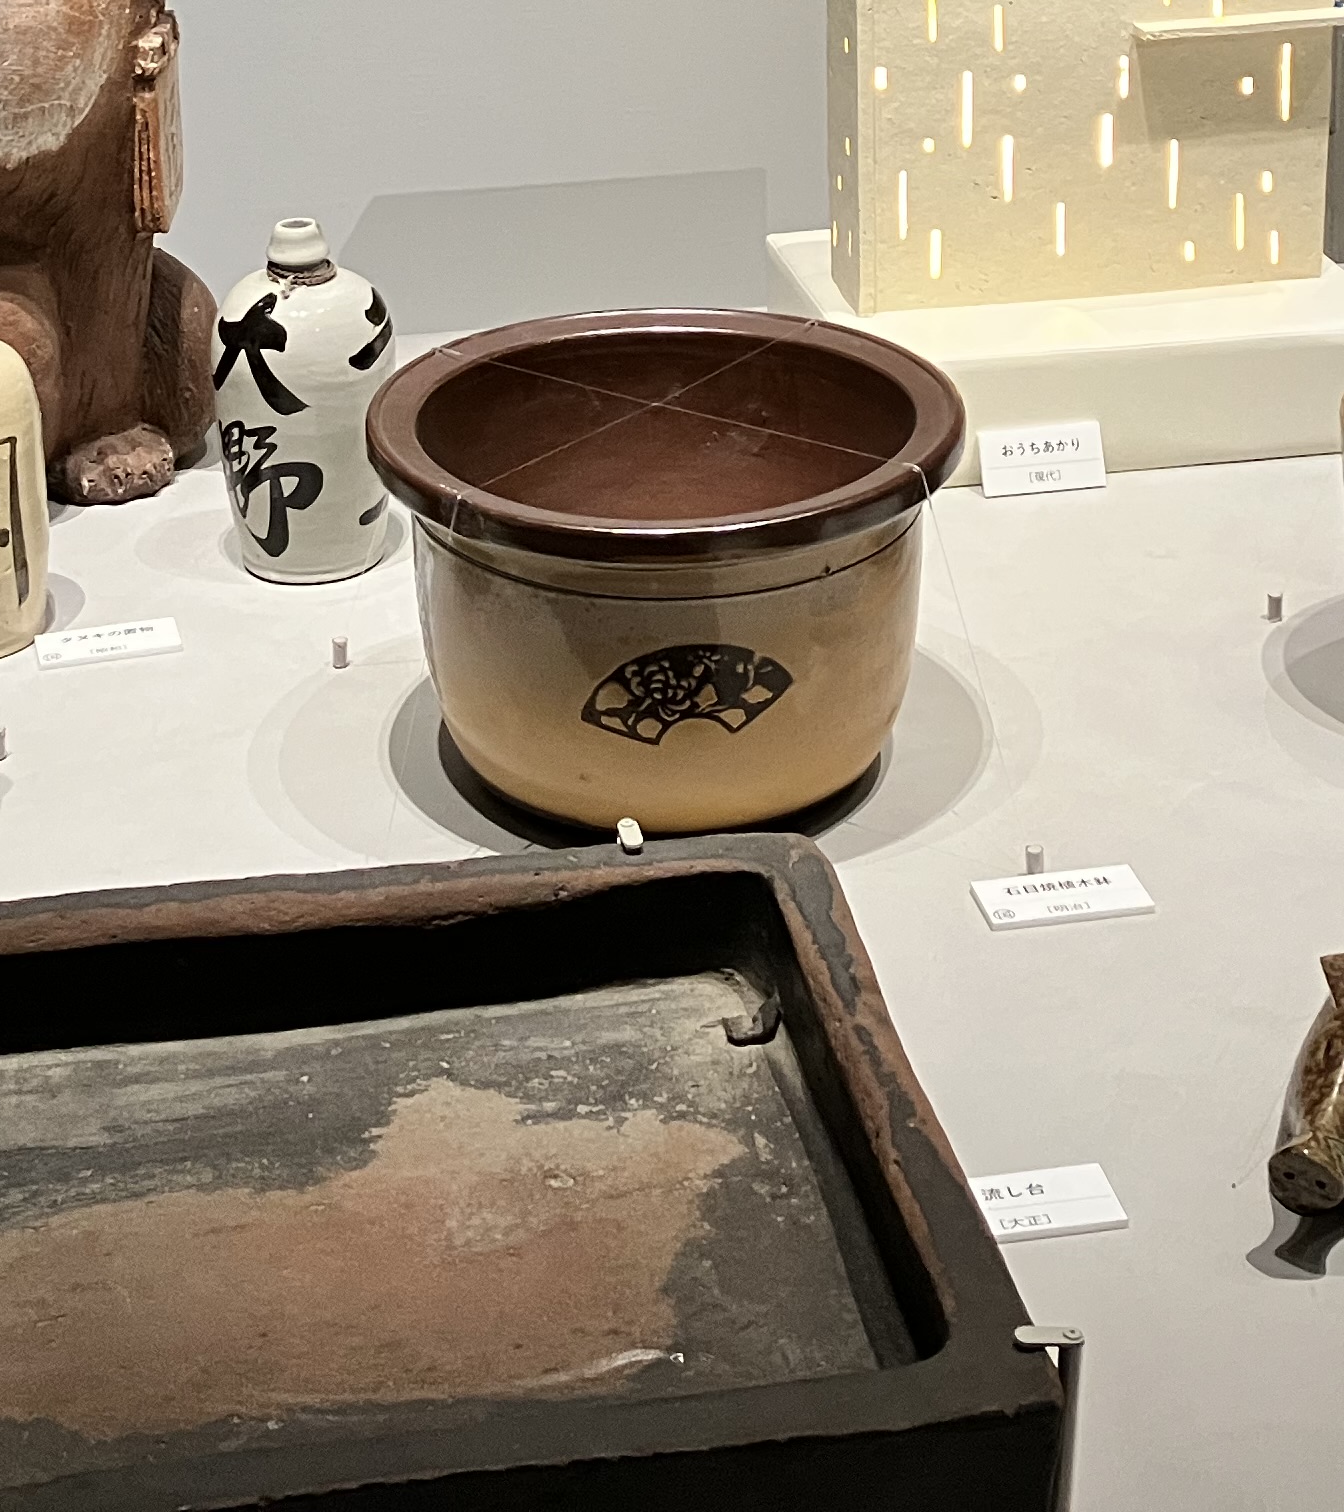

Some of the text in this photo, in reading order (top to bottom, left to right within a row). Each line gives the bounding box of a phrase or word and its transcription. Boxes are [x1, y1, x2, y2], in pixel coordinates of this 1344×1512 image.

[1002, 438, 1080, 457] おうちあかり
[981, 1183, 1045, 1201] 流し台
